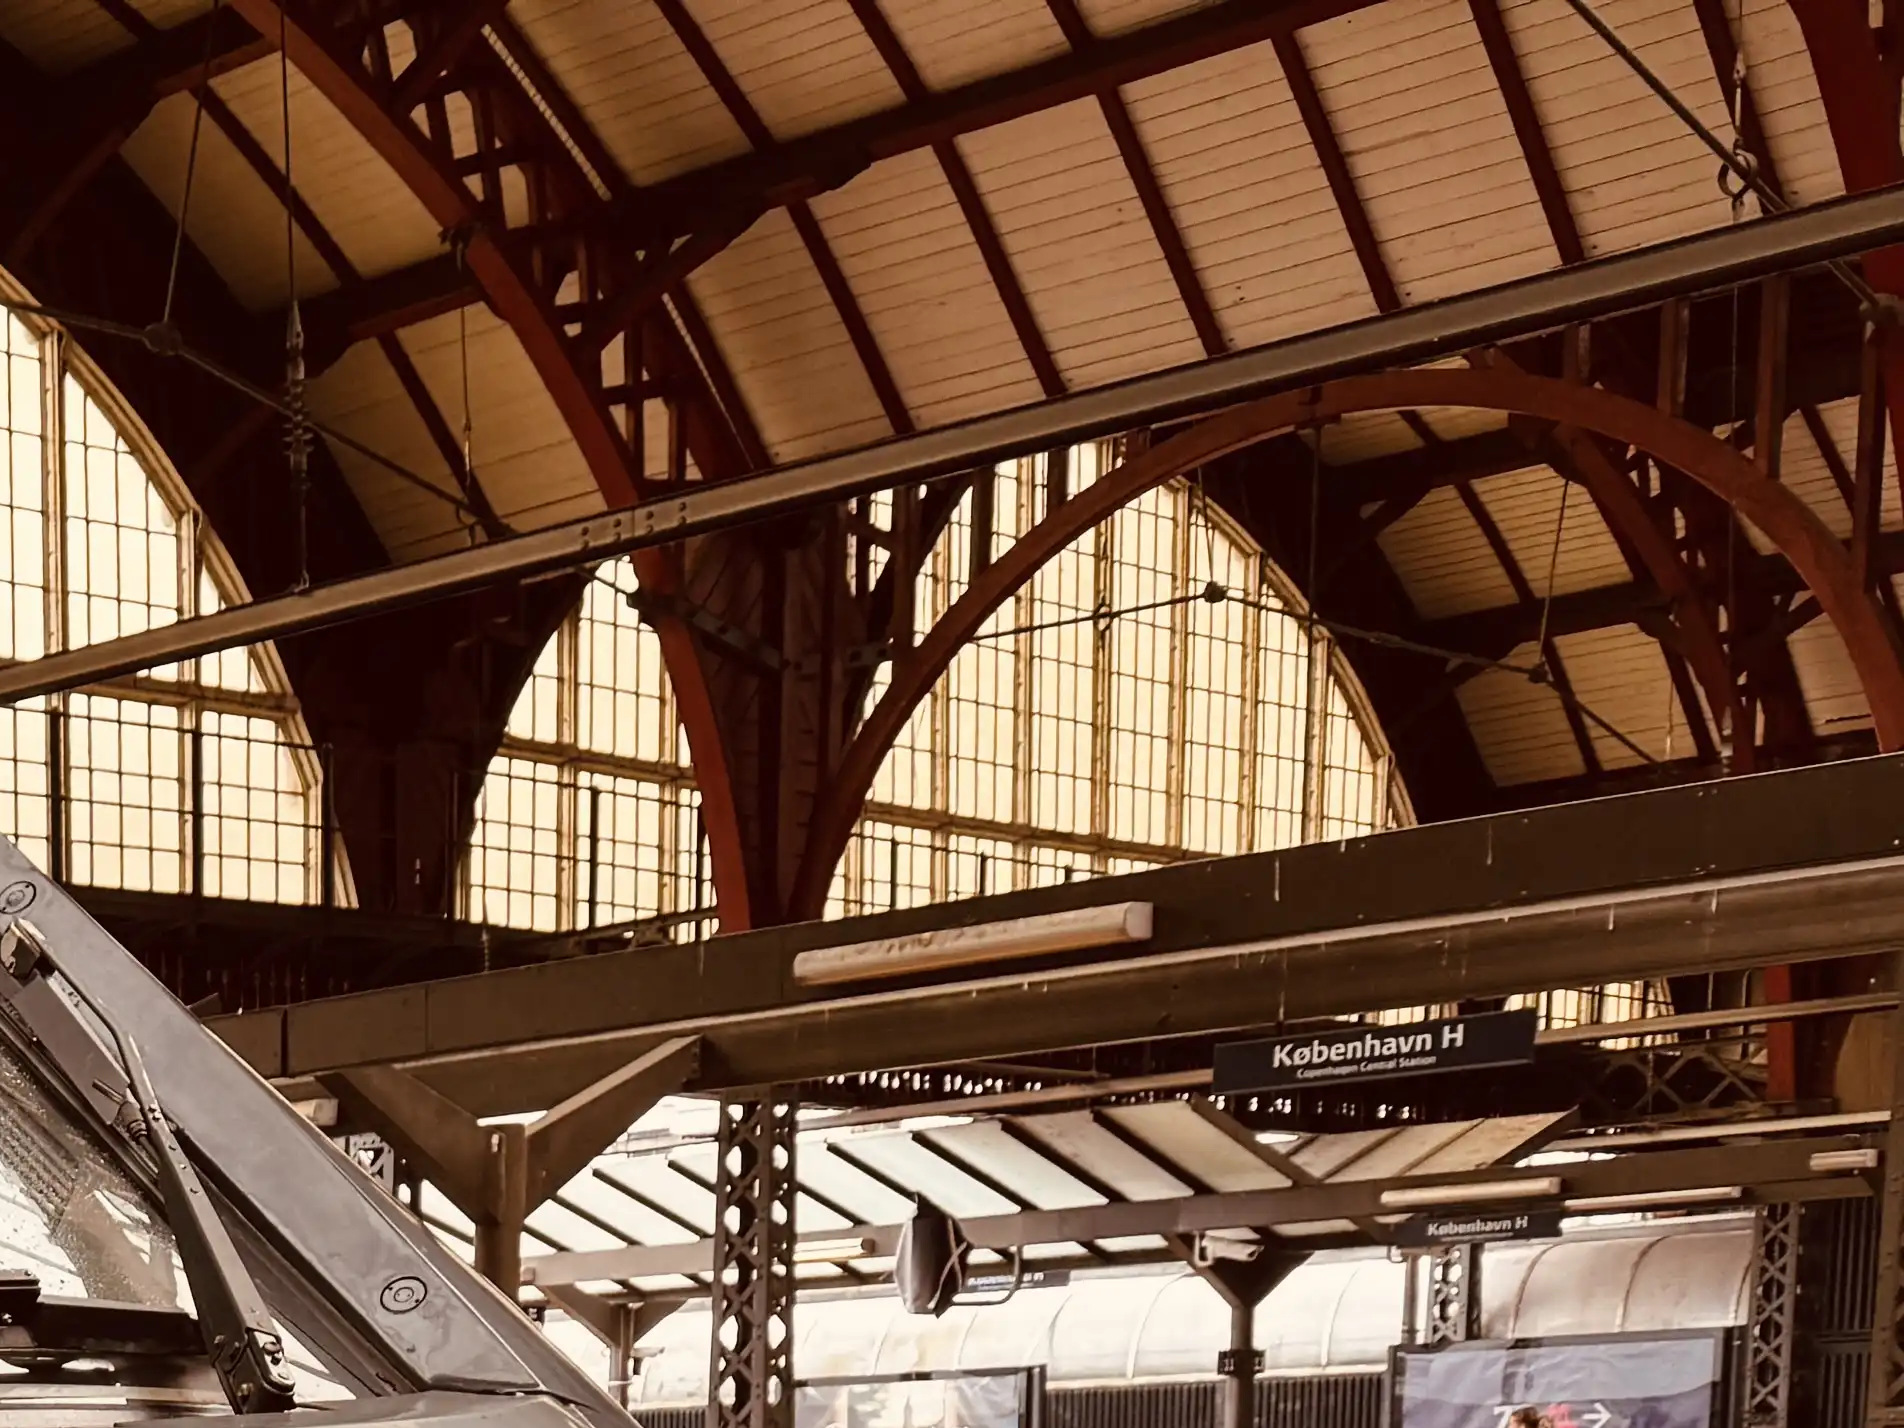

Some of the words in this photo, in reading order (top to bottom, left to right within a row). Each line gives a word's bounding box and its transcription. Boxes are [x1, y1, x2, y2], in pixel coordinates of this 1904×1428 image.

[1272, 1032, 1432, 1068] København
[1442, 1022, 1465, 1048] H
[1297, 1064, 1358, 1079] Copenhagen
[1399, 1055, 1437, 1068] Station
[1427, 1217, 1512, 1237] København
[1515, 1215, 1529, 1230] H
